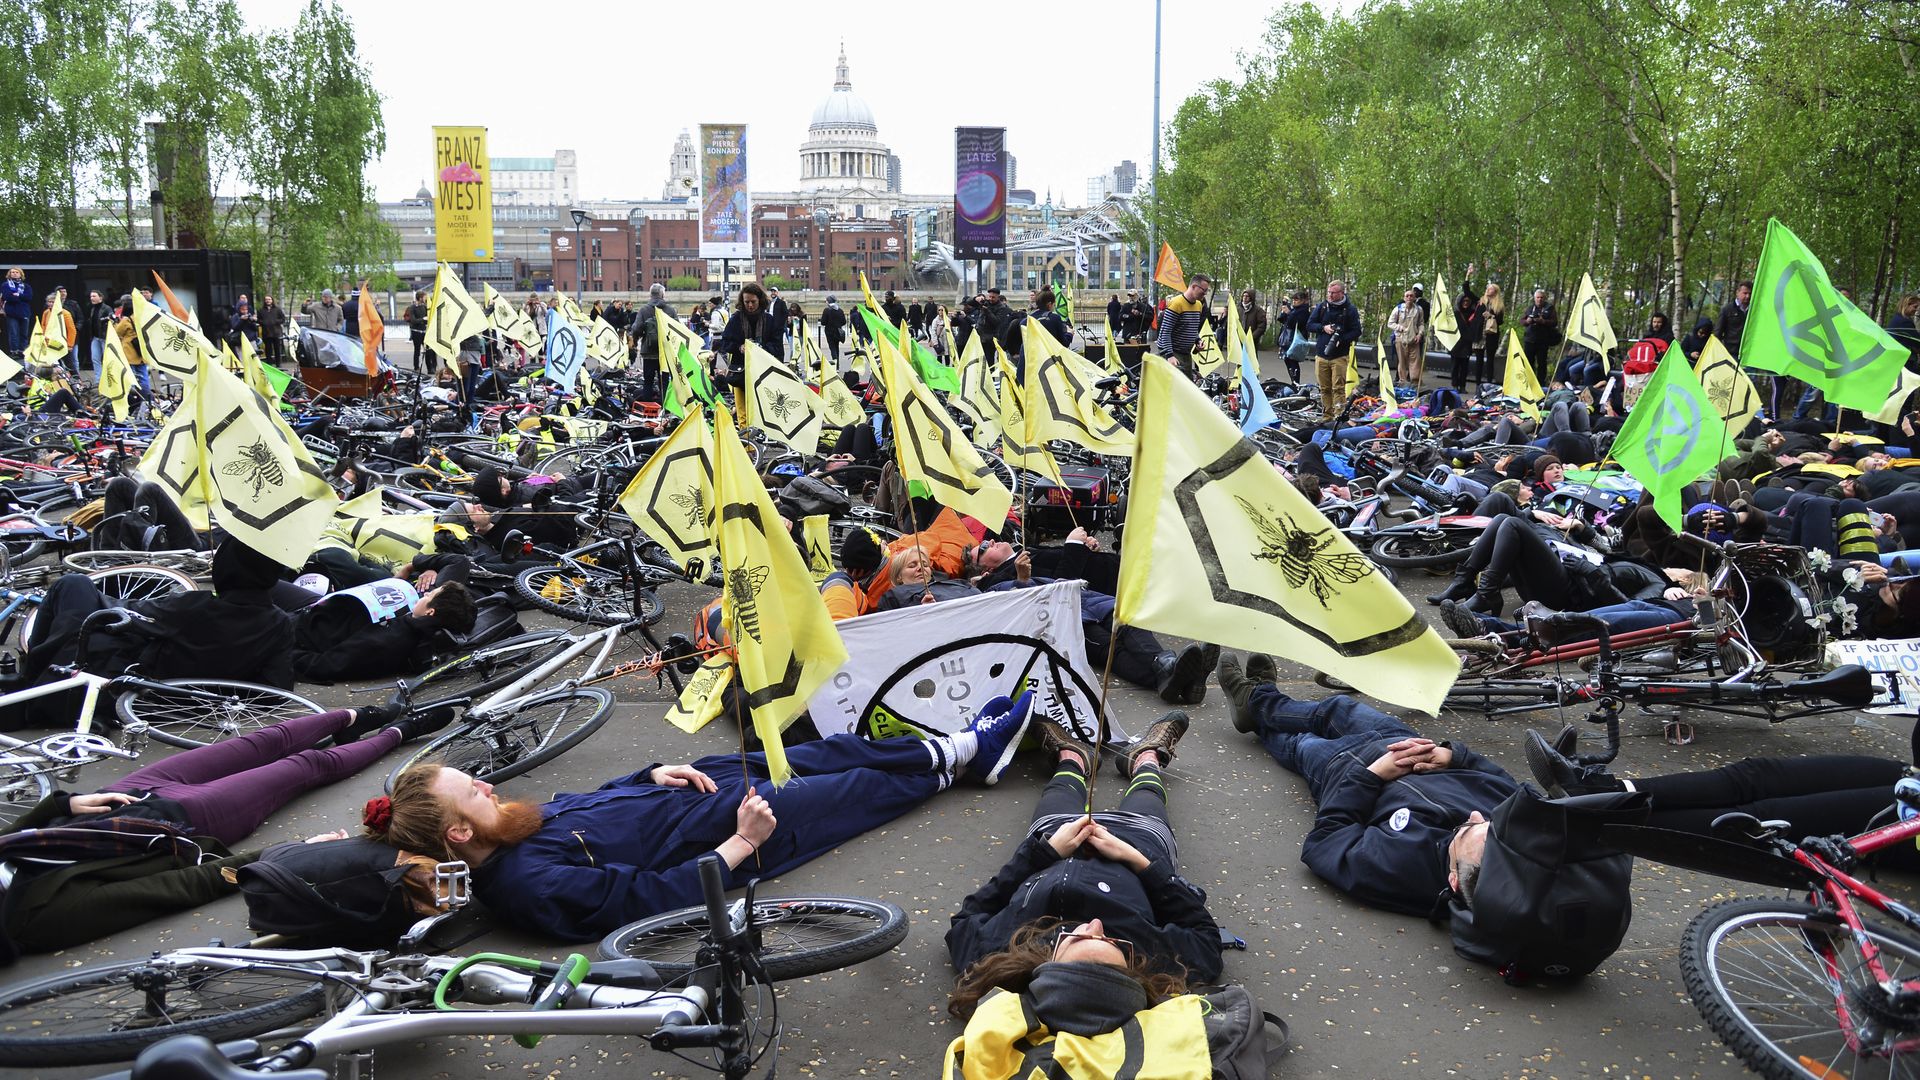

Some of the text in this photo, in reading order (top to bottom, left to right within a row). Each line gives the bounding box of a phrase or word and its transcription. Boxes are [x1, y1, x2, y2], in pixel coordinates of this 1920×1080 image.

[971, 142, 994, 151] TATE
[437, 136, 482, 169] FRANZ
[967, 152, 997, 162] LATES
[439, 181, 483, 210] WEST
[1842, 644, 1857, 653] IF
[1866, 643, 1899, 653] NOT
